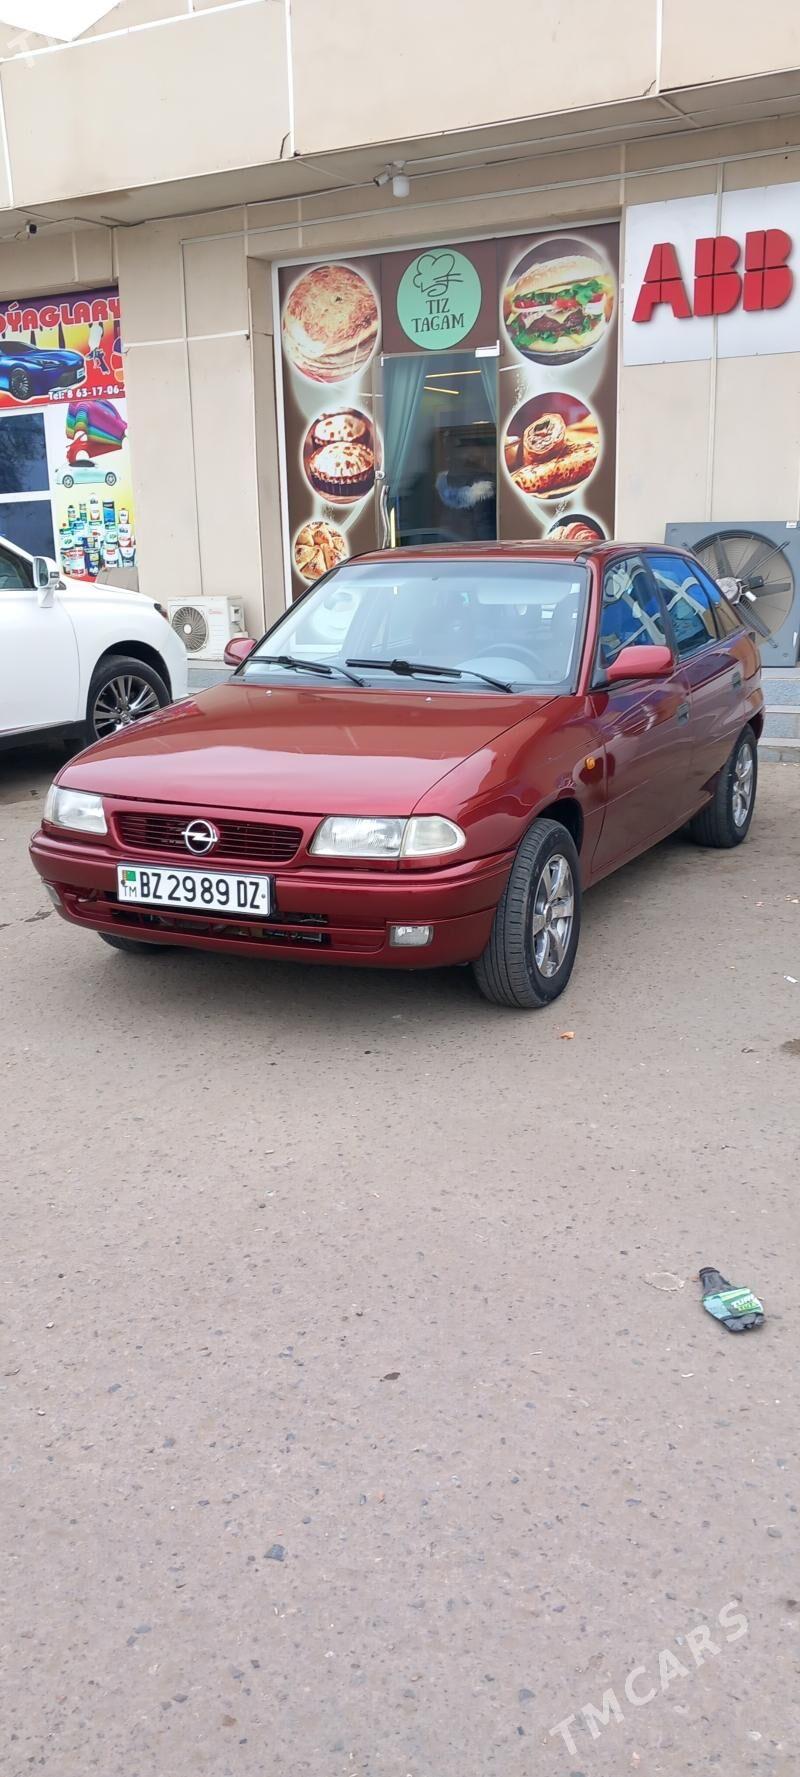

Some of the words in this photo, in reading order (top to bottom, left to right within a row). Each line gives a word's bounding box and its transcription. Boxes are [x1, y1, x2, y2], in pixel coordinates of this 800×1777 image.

[632, 228, 794, 323] ABB
[425, 297, 450, 314] TIZ
[411, 312, 464, 333] TAGAM
[48, 391, 65, 401] Tel:
[67, 389, 73, 399] 8
[123, 885, 137, 898] TM
